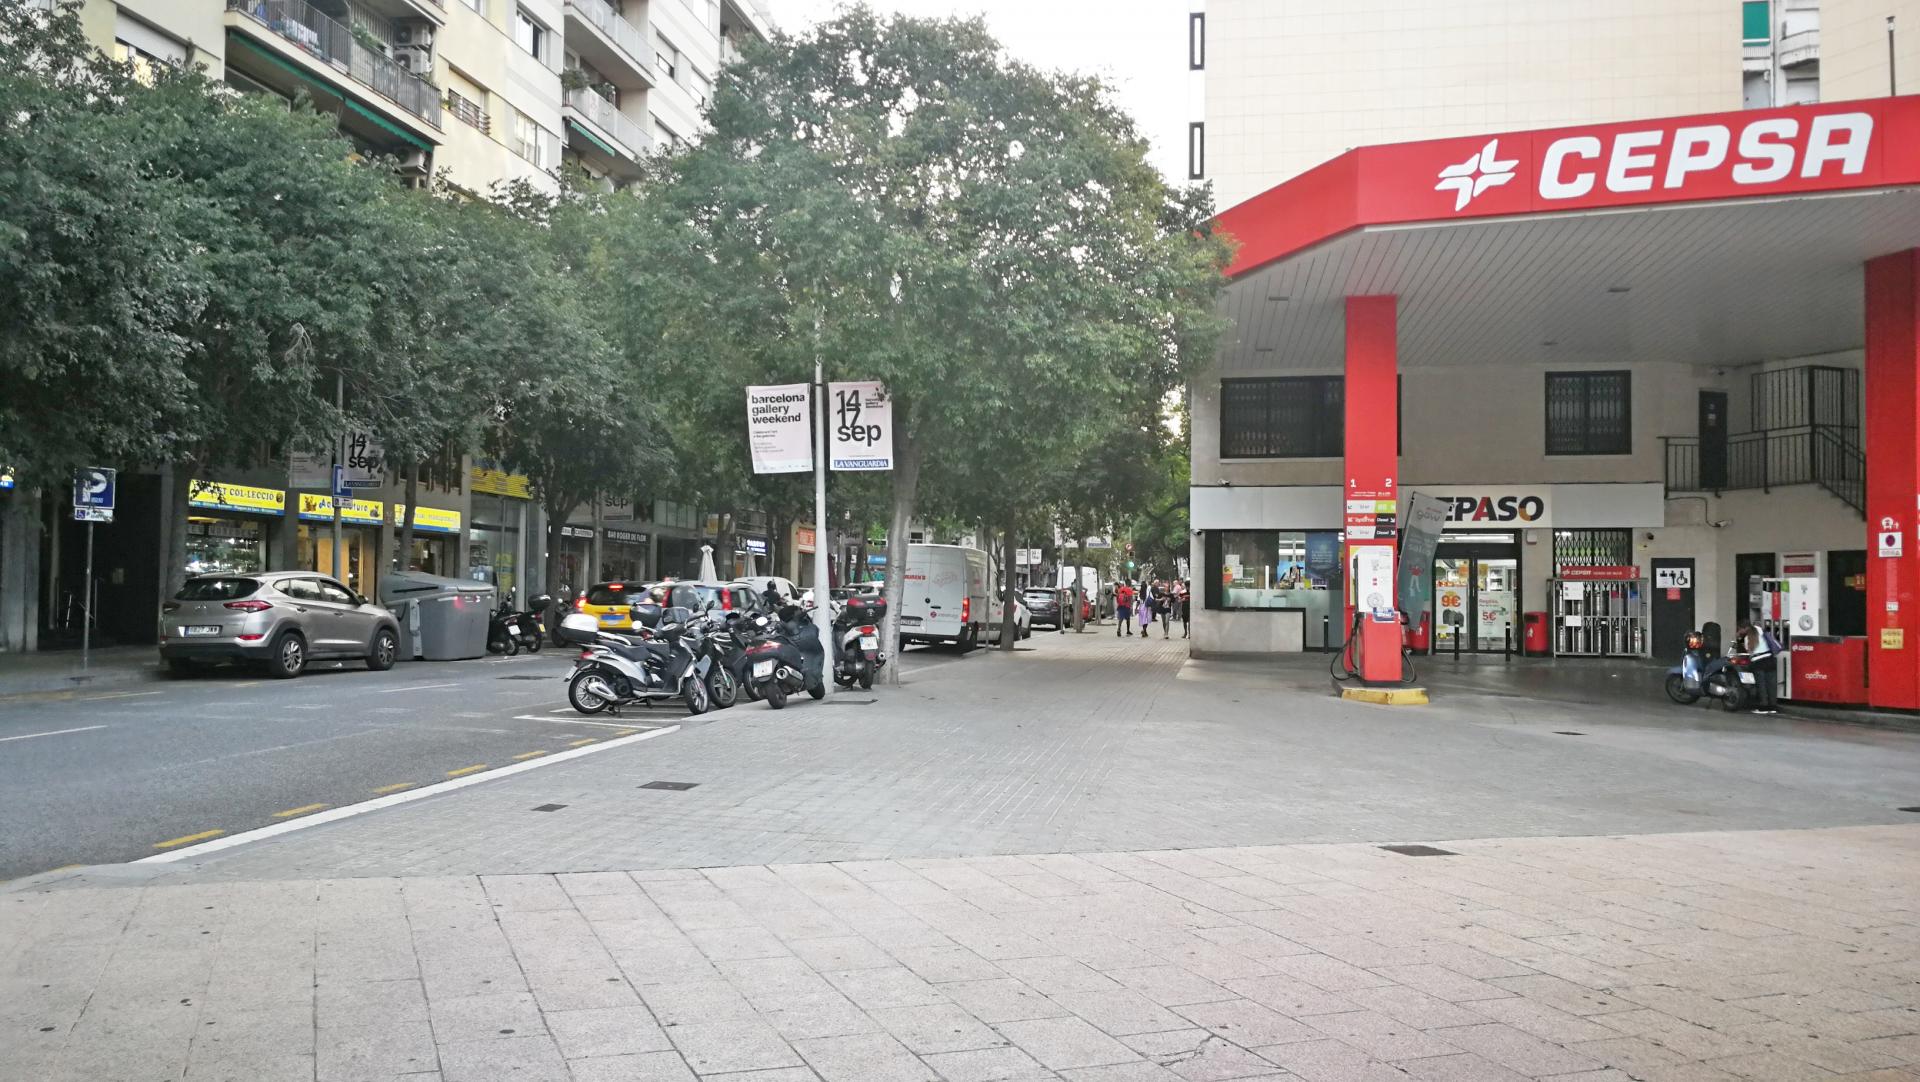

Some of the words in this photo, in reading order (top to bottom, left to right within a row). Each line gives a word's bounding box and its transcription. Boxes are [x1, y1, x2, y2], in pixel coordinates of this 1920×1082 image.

[1538, 112, 1874, 200] CEPSA
[751, 393, 805, 404] barcelona
[836, 389, 861, 408] 14
[752, 405, 790, 416] gallery
[753, 413, 801, 424] weekend
[837, 407, 861, 428] 17
[837, 424, 882, 447] sep
[348, 456, 378, 473] sep
[835, 460, 846, 468] LA
[846, 459, 888, 468] VANGUARDIA
[1350, 478, 1357, 488] 1
[1385, 477, 1392, 488] 2
[1435, 495, 1544, 522] EPASO
[1441, 595, 1461, 607] 9€
[1482, 611, 1497, 621] 5€
